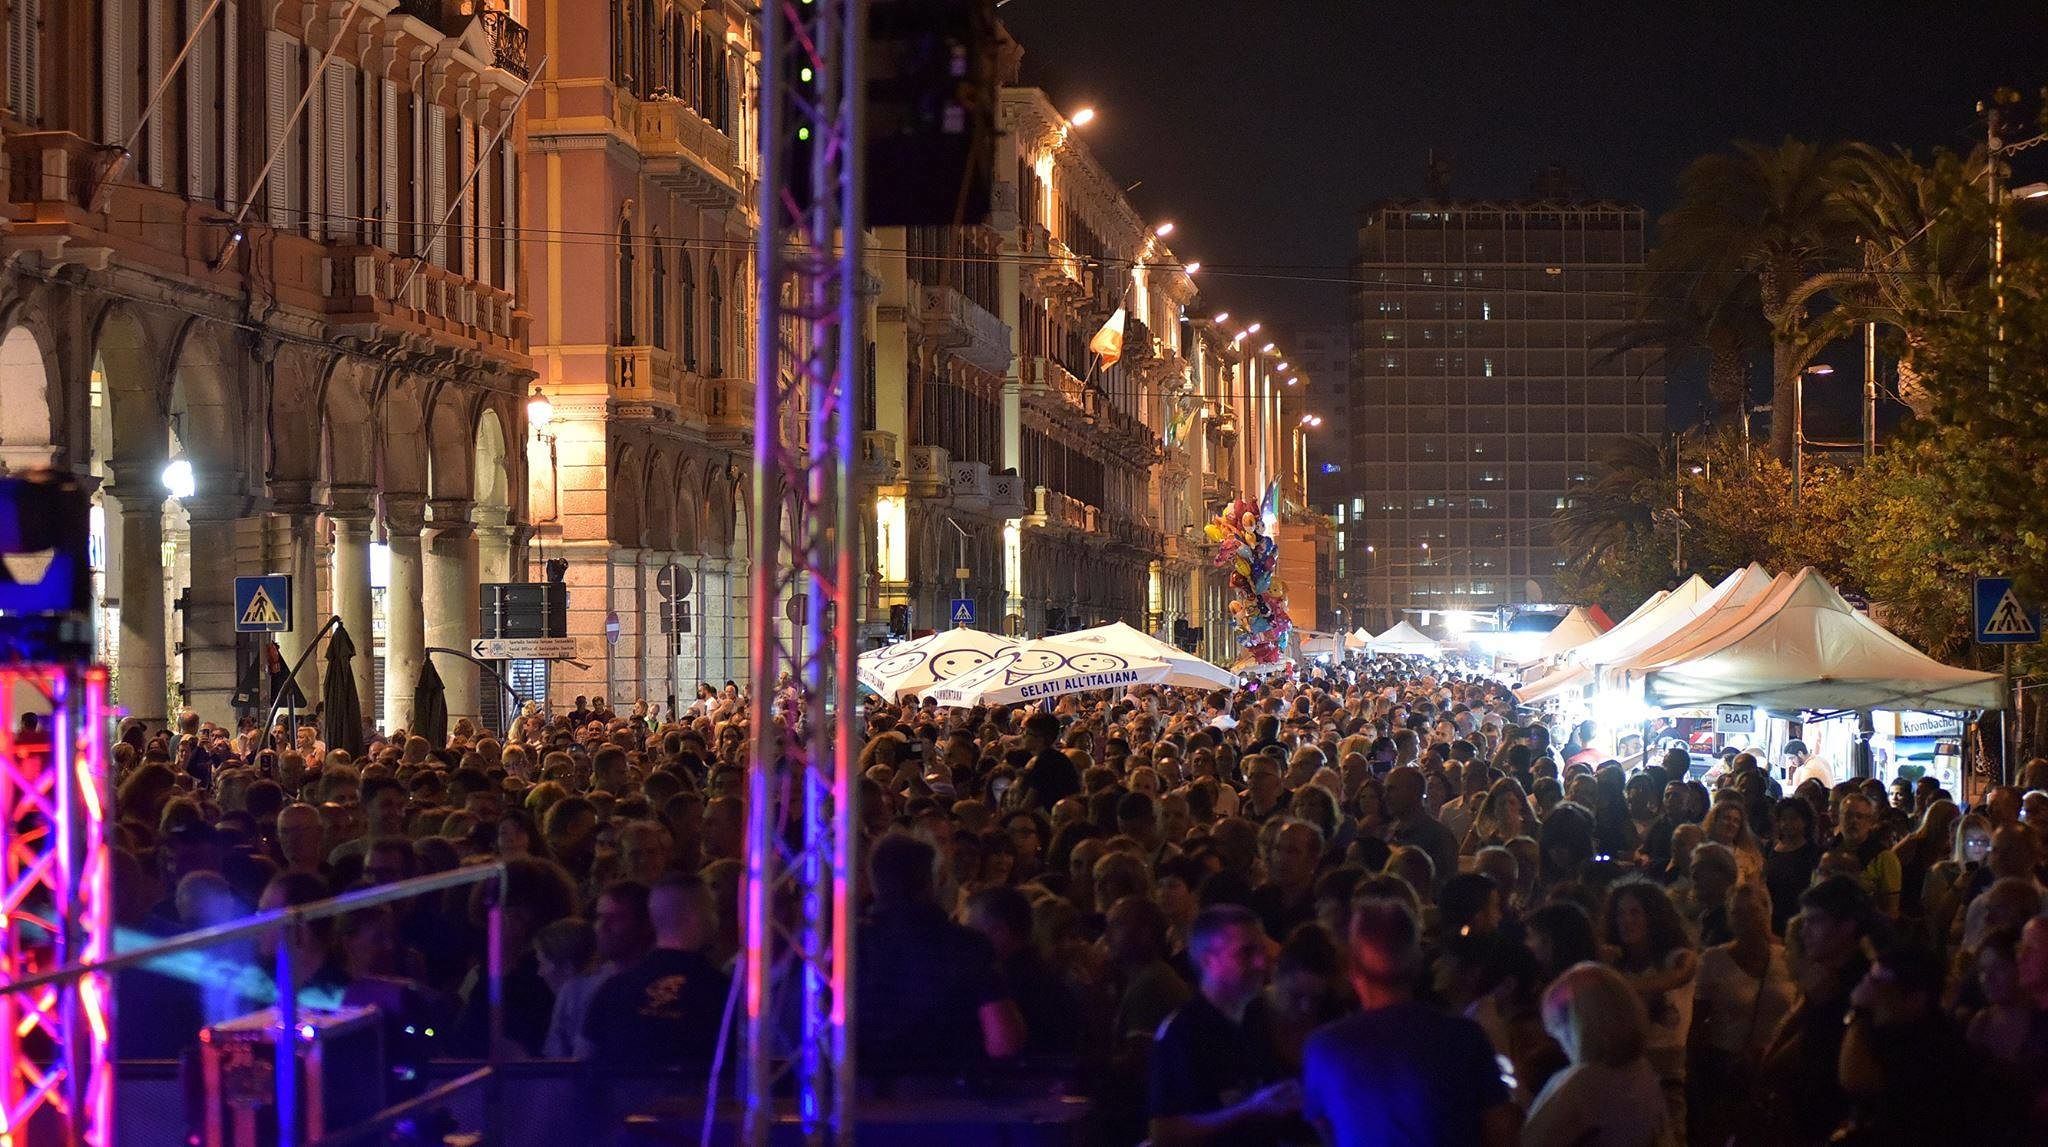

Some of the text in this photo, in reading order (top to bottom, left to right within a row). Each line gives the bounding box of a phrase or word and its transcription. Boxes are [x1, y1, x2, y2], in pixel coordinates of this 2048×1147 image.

[1020, 670, 1138, 698] GELATI ALL'ITALIANA
[1725, 713, 1749, 724] BAR
[1903, 718, 1956, 733] Krombacher
